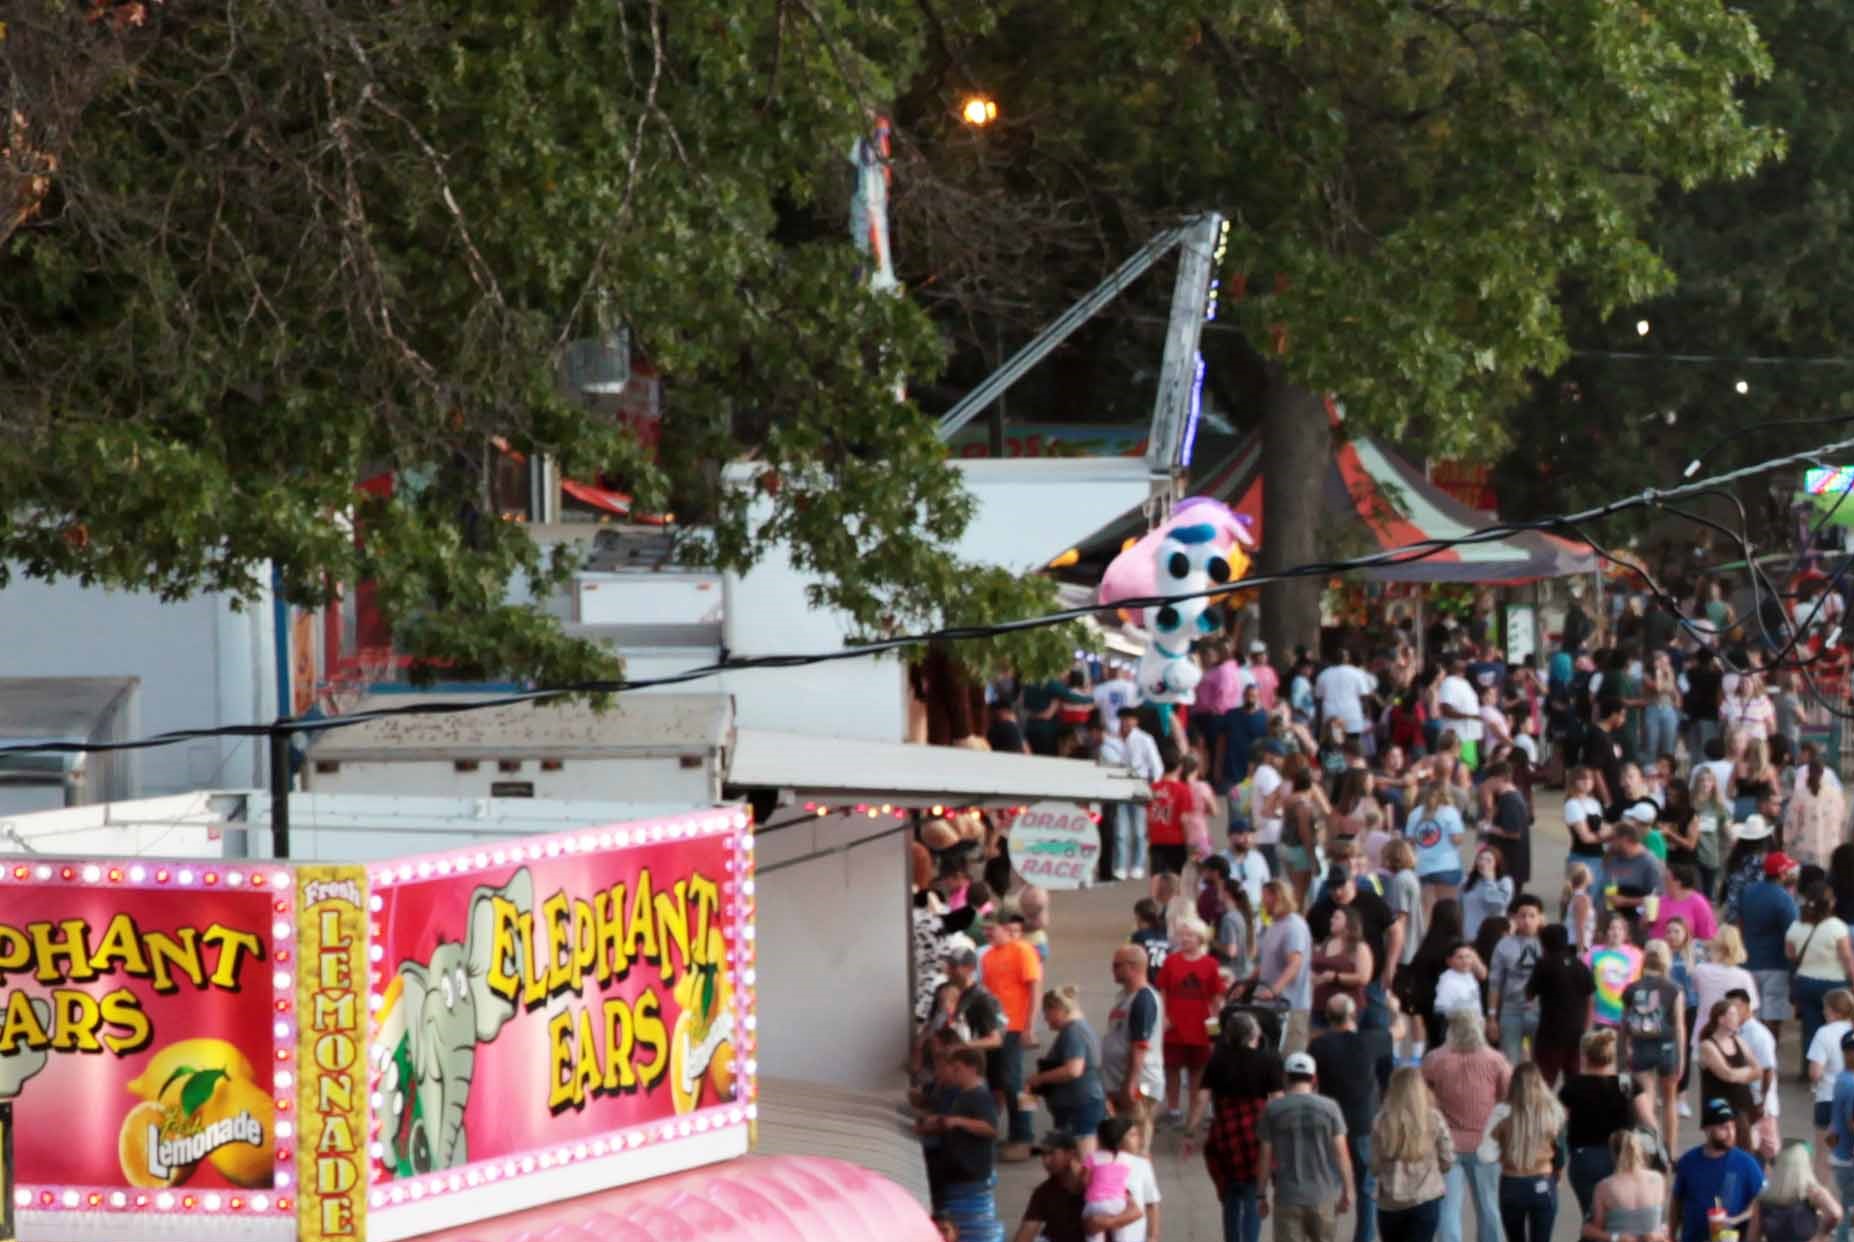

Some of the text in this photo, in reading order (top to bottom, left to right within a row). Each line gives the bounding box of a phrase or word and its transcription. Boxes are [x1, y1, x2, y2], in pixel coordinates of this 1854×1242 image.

[1021, 813, 1088, 832] DRAG
[1022, 858, 1084, 878] RACE
[487, 866, 722, 1012] ELEPHANT
[312, 910, 358, 1236] LEMONADE
[548, 988, 670, 1116] EARS
[148, 1111, 263, 1180] Lemonade
